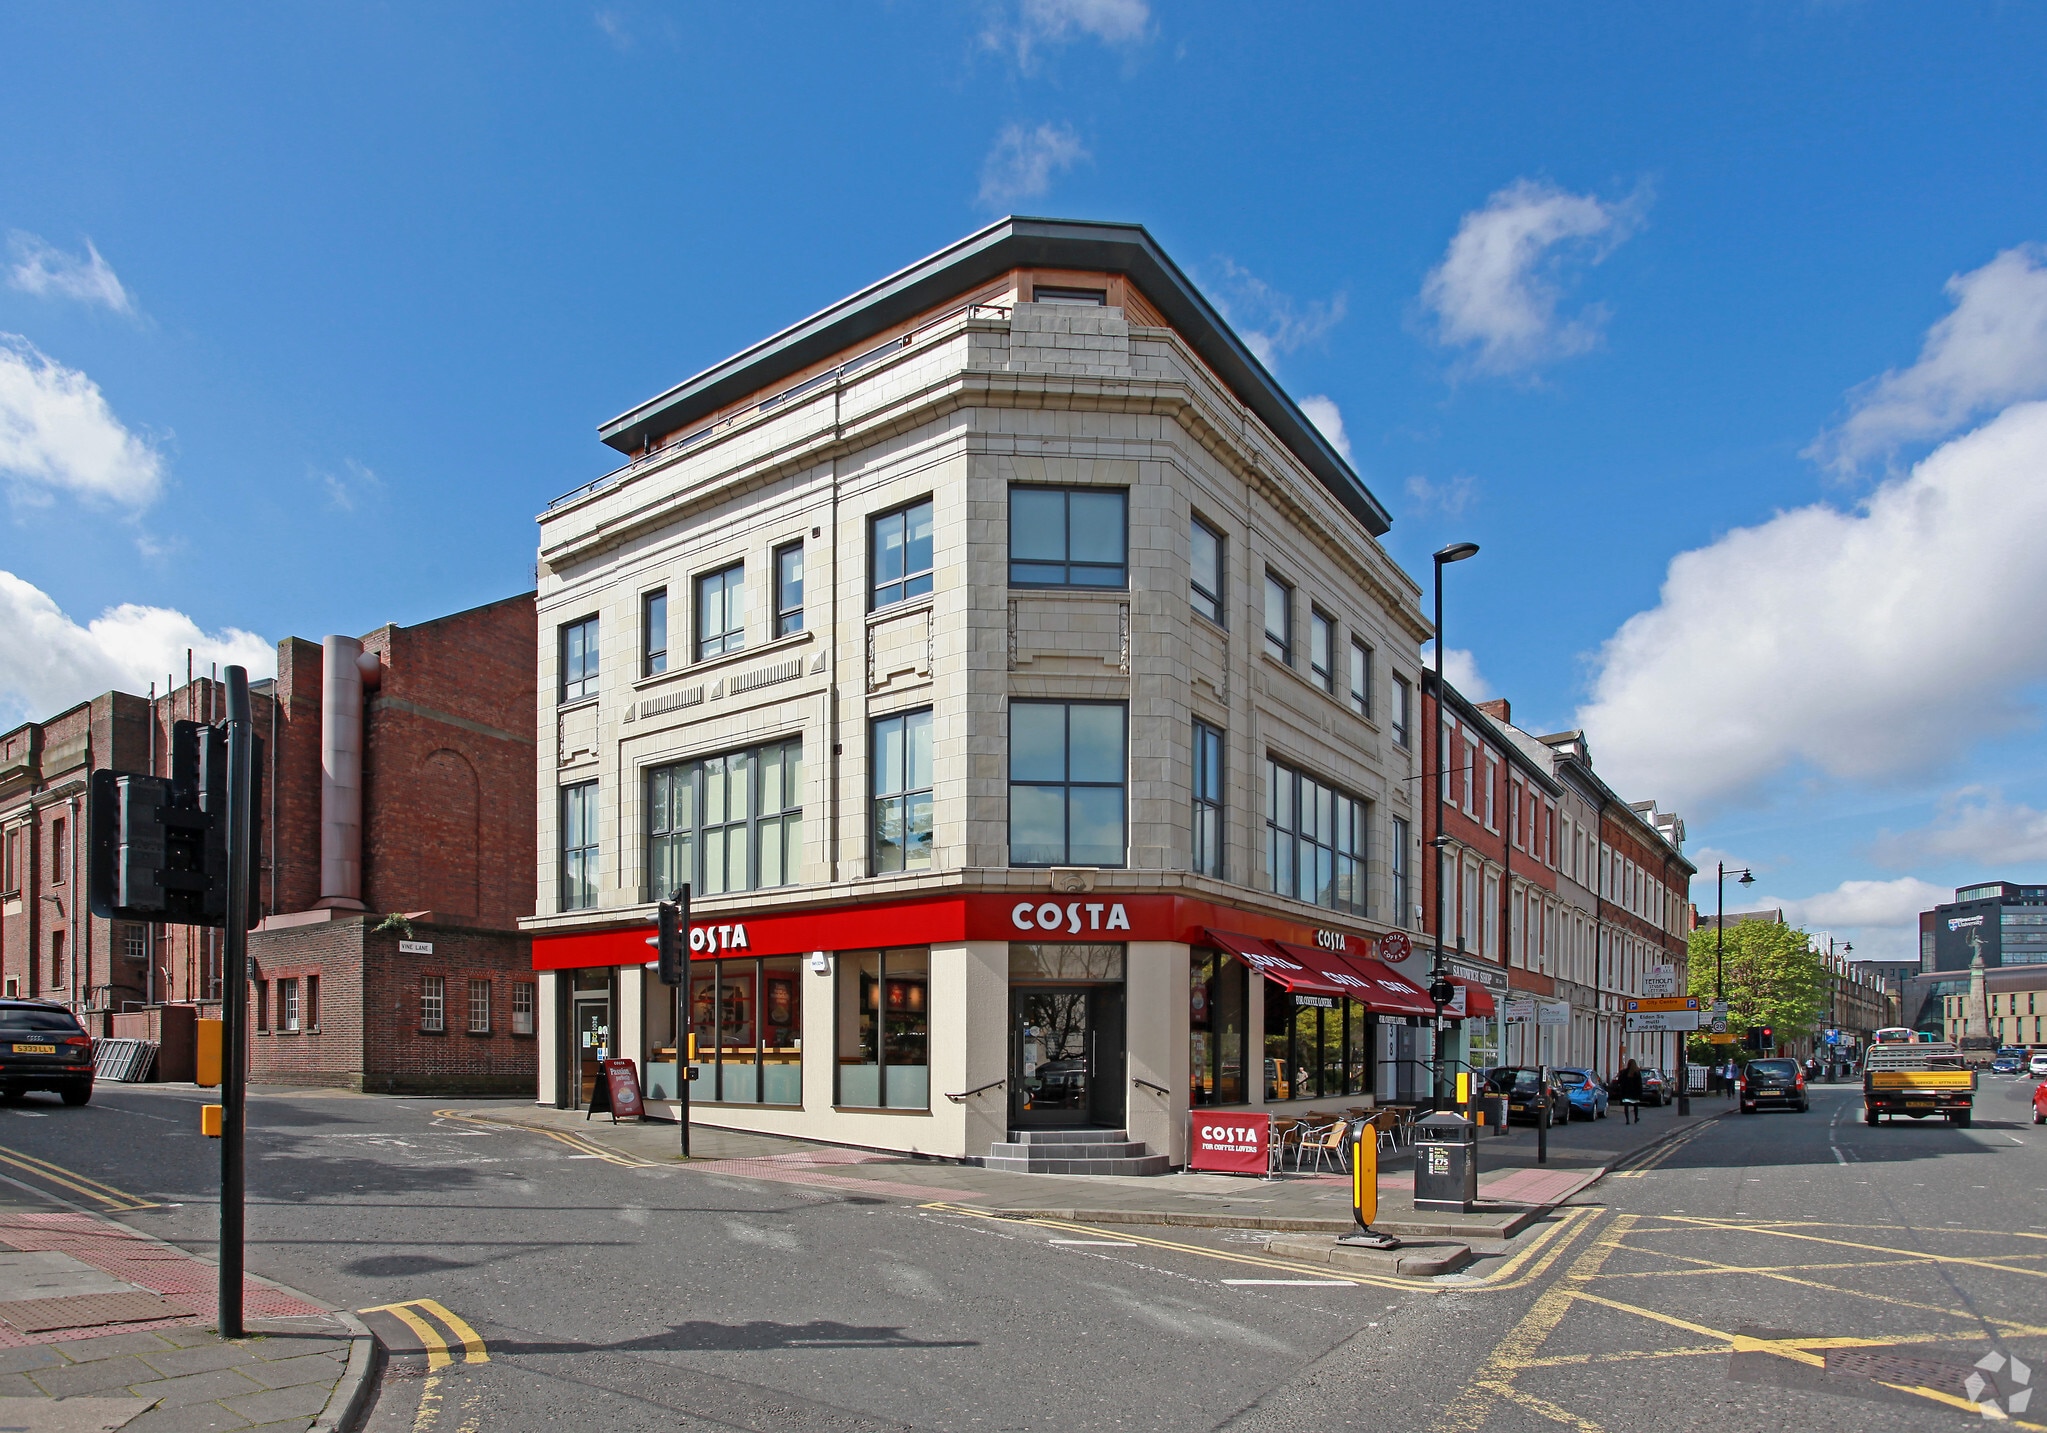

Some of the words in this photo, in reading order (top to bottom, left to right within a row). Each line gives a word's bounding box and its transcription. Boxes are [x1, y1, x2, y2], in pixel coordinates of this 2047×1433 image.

[1012, 902, 1131, 934] COSTA
[1958, 920, 1984, 928] University
[680, 923, 748, 953] OSTA
[1318, 929, 1347, 951] COSTA
[1385, 934, 1405, 944] COSTA
[1383, 950, 1406, 960] COFFEE
[1452, 965, 1479, 982] SANDWICH
[1480, 971, 1492, 985] SHOP
[1296, 995, 1304, 1004] FOR
[1304, 996, 1318, 1006] COFFEE
[1318, 997, 1332, 1007] LOVERS
[1201, 1126, 1258, 1143] COSTA
[1236, 1145, 1258, 1153] LOVERS
